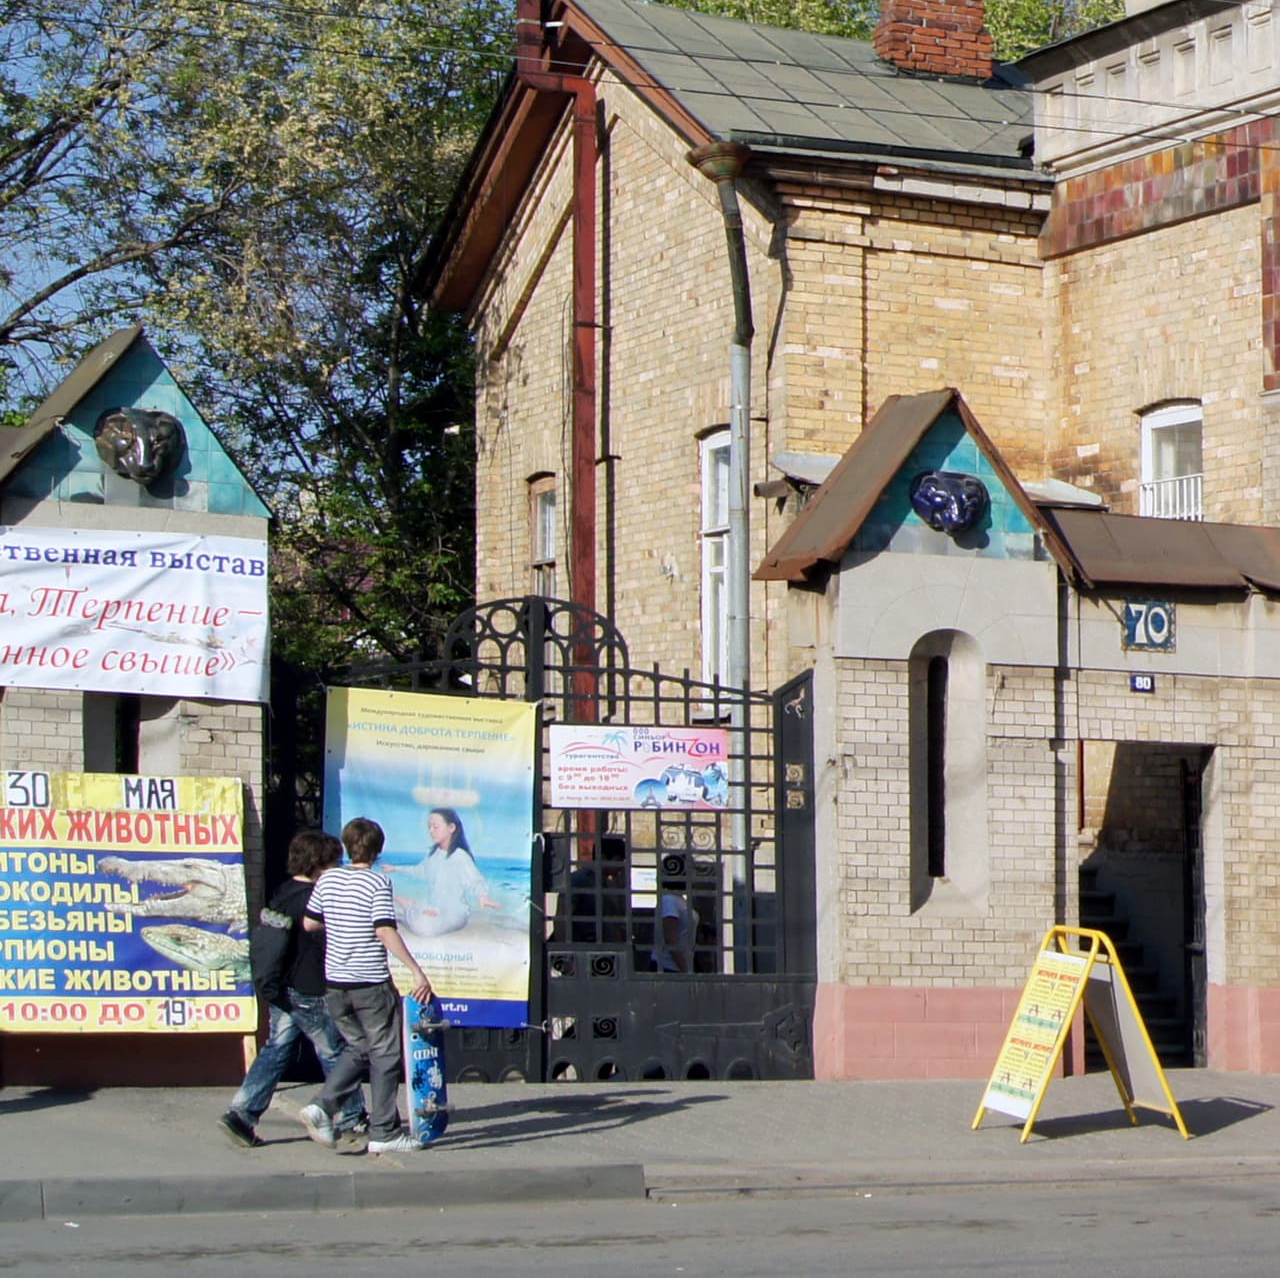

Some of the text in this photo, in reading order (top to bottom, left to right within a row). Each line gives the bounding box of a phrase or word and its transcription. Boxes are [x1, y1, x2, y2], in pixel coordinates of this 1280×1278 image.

[0, 544, 265, 576] твенная выстав
[27, 586, 229, 630] Терпение
[1128, 603, 1168, 643] 70
[101, 650, 236, 677] свыше»
[8, 772, 176, 810] 30 МАЯ
[67, 810, 240, 846] ЖИВОТНЫХ
[64, 969, 237, 991] ЖИВОТНЫЕ
[2, 1002, 88, 1021] 10:00
[99, 1003, 145, 1025] ДО
